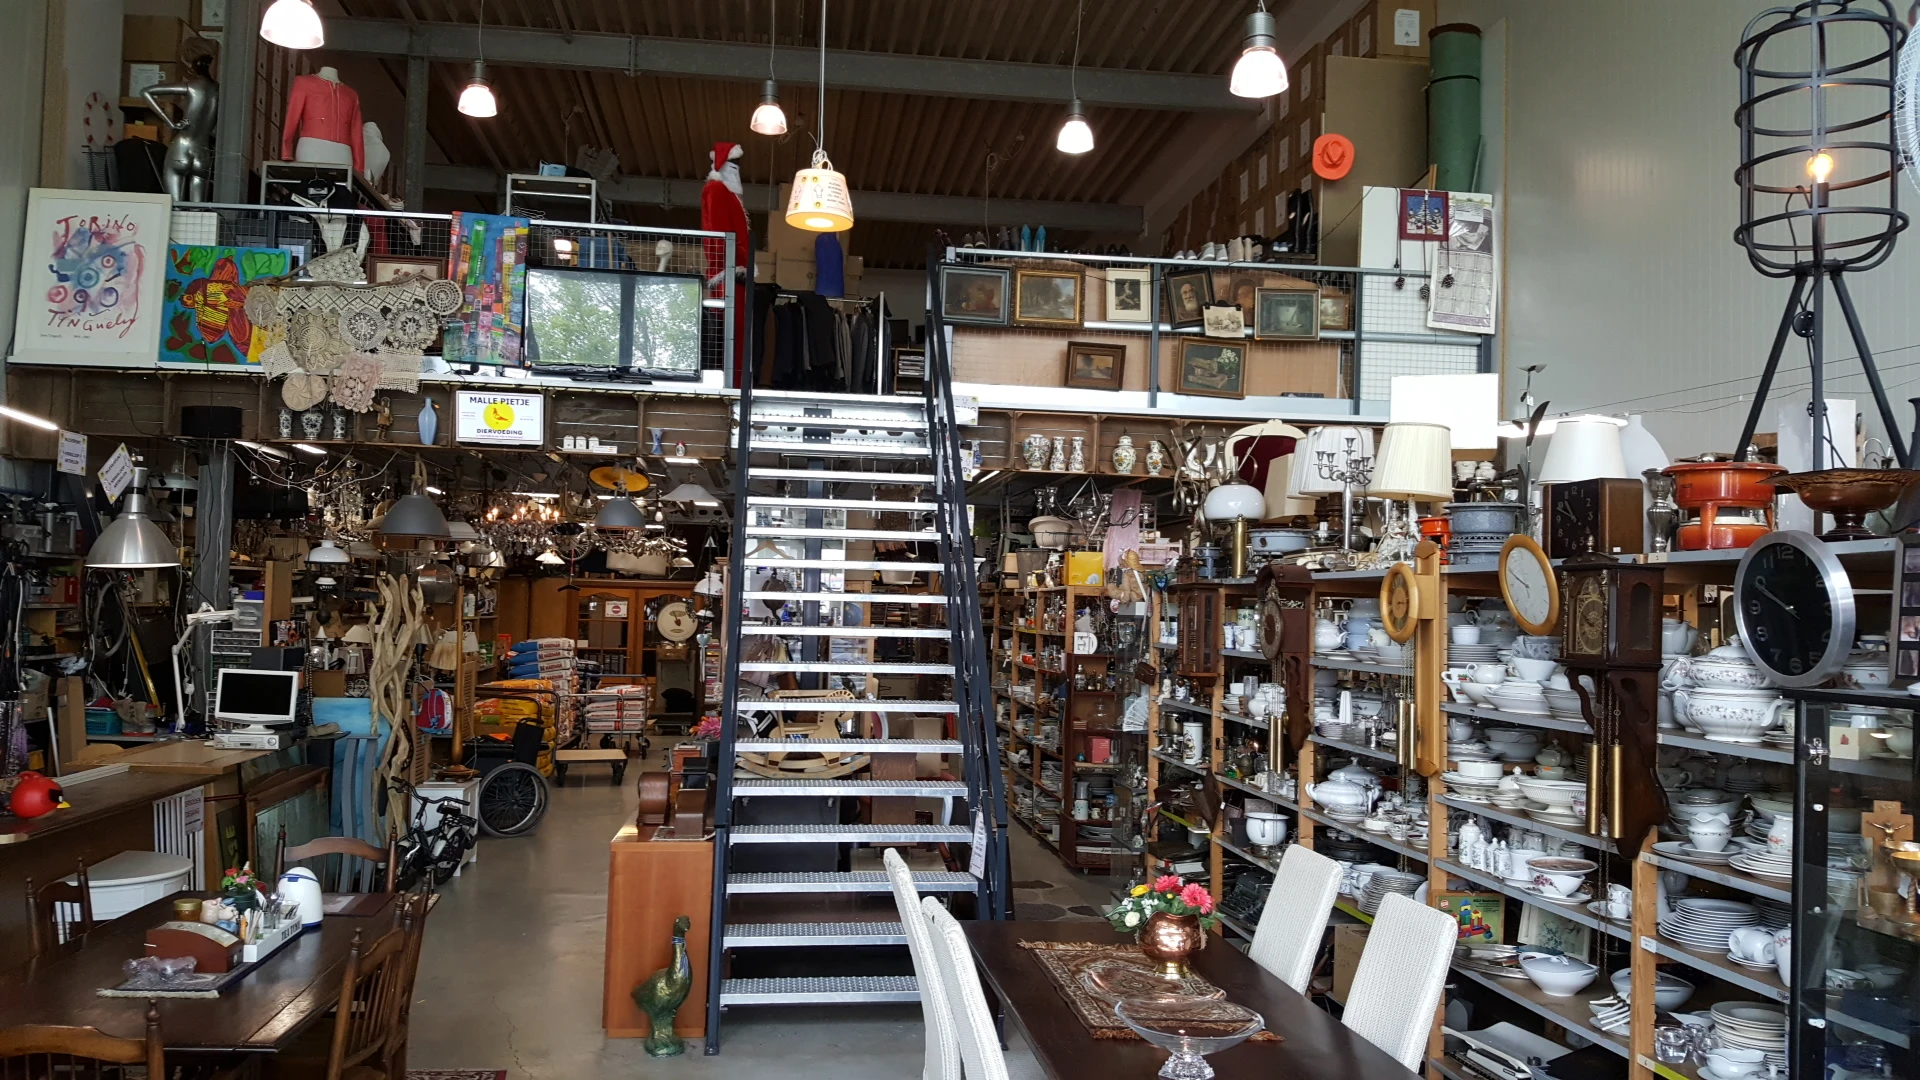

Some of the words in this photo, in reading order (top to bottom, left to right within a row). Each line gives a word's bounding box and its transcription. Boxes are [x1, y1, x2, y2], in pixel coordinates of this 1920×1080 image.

[469, 396, 498, 405] MALLE
[500, 398, 530, 406] PIETJE
[1776, 545, 1794, 559] 12
[1763, 555, 1774, 569] 11
[1749, 600, 1761, 615] 9
[1756, 626, 1768, 642] 8
[1769, 648, 1781, 662] 7
[1808, 651, 1822, 667] 5
[1789, 657, 1803, 674] 6
[281, 928, 290, 941] TEA
